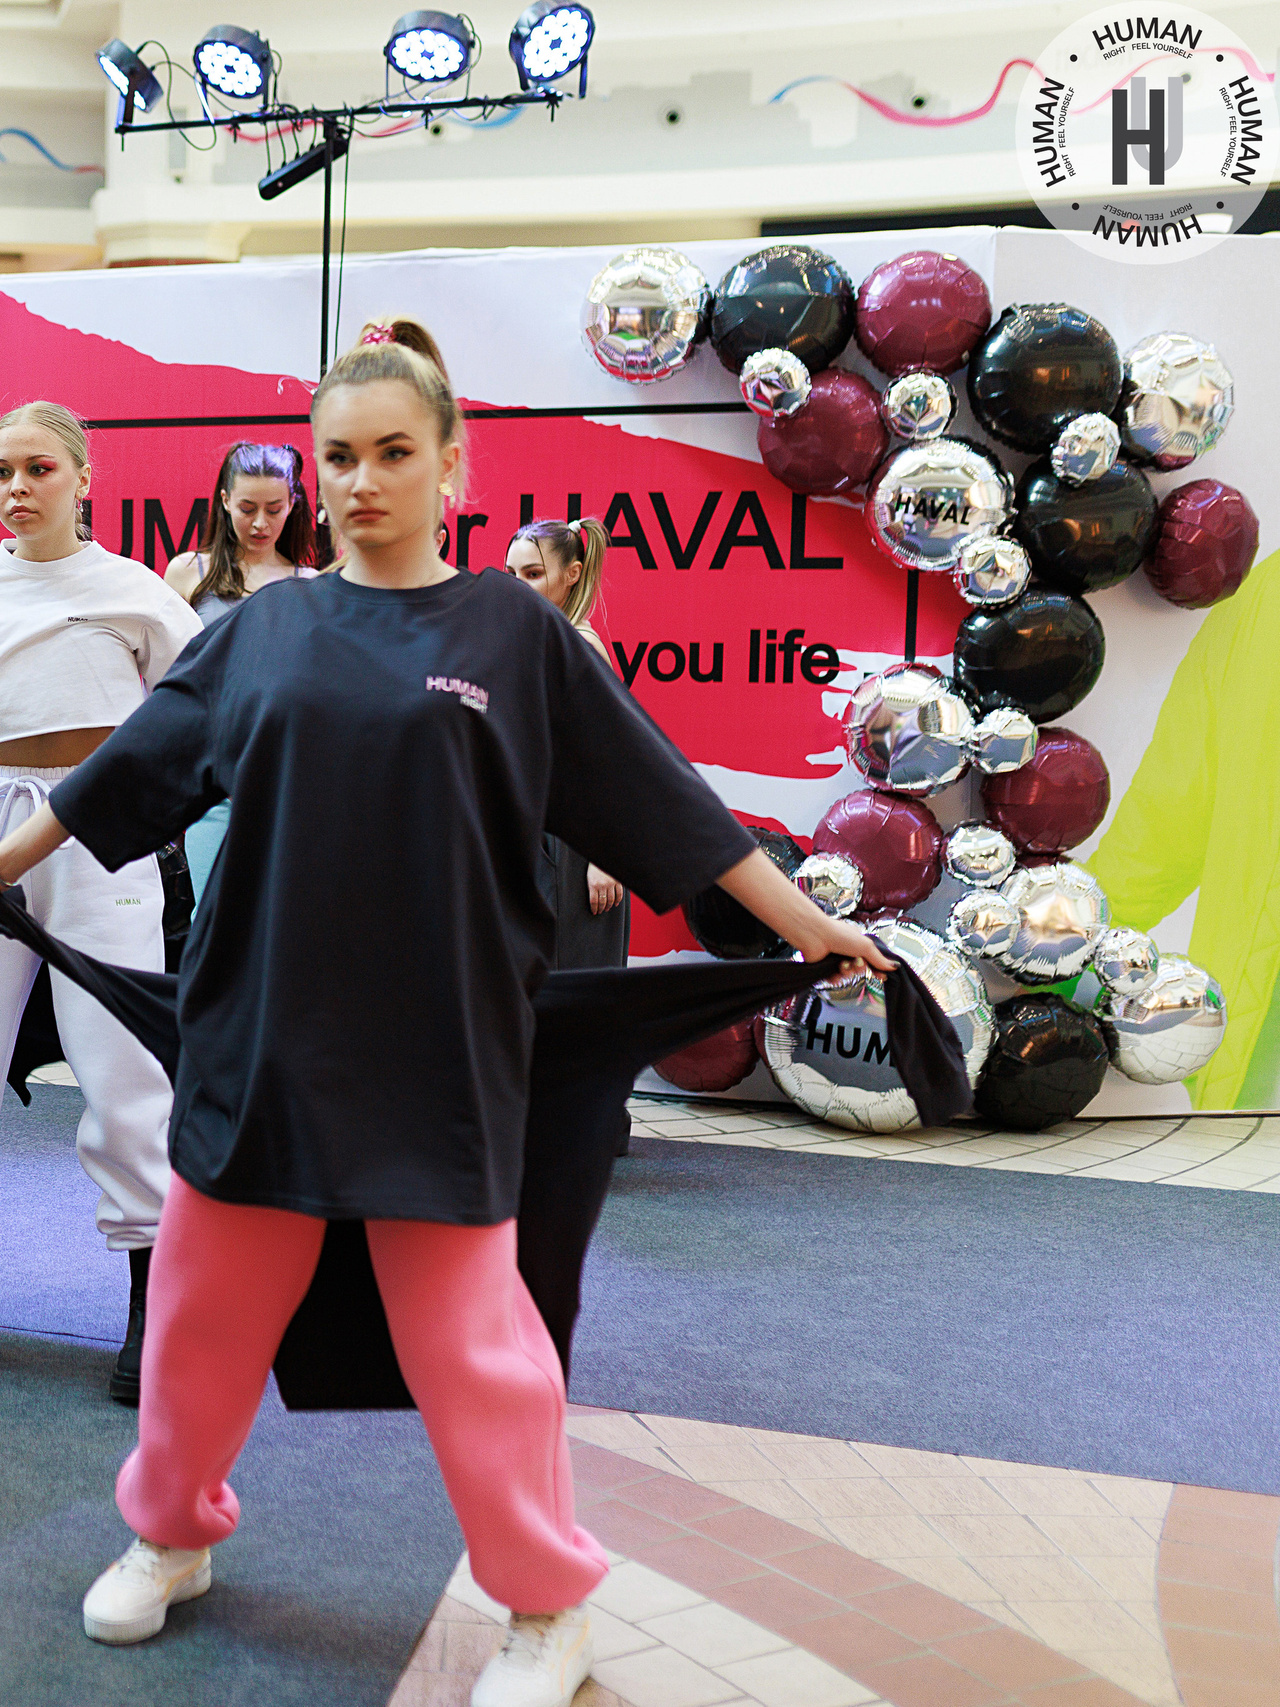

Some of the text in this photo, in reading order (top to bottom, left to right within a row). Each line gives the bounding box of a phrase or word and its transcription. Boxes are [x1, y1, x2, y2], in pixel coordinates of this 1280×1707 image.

[894, 493, 971, 526] HAVAL
[611, 628, 841, 692] you life
[426, 676, 489, 705] HUMAN
[115, 898, 142, 906] HUMAN
[806, 1018, 897, 1068] HUM
